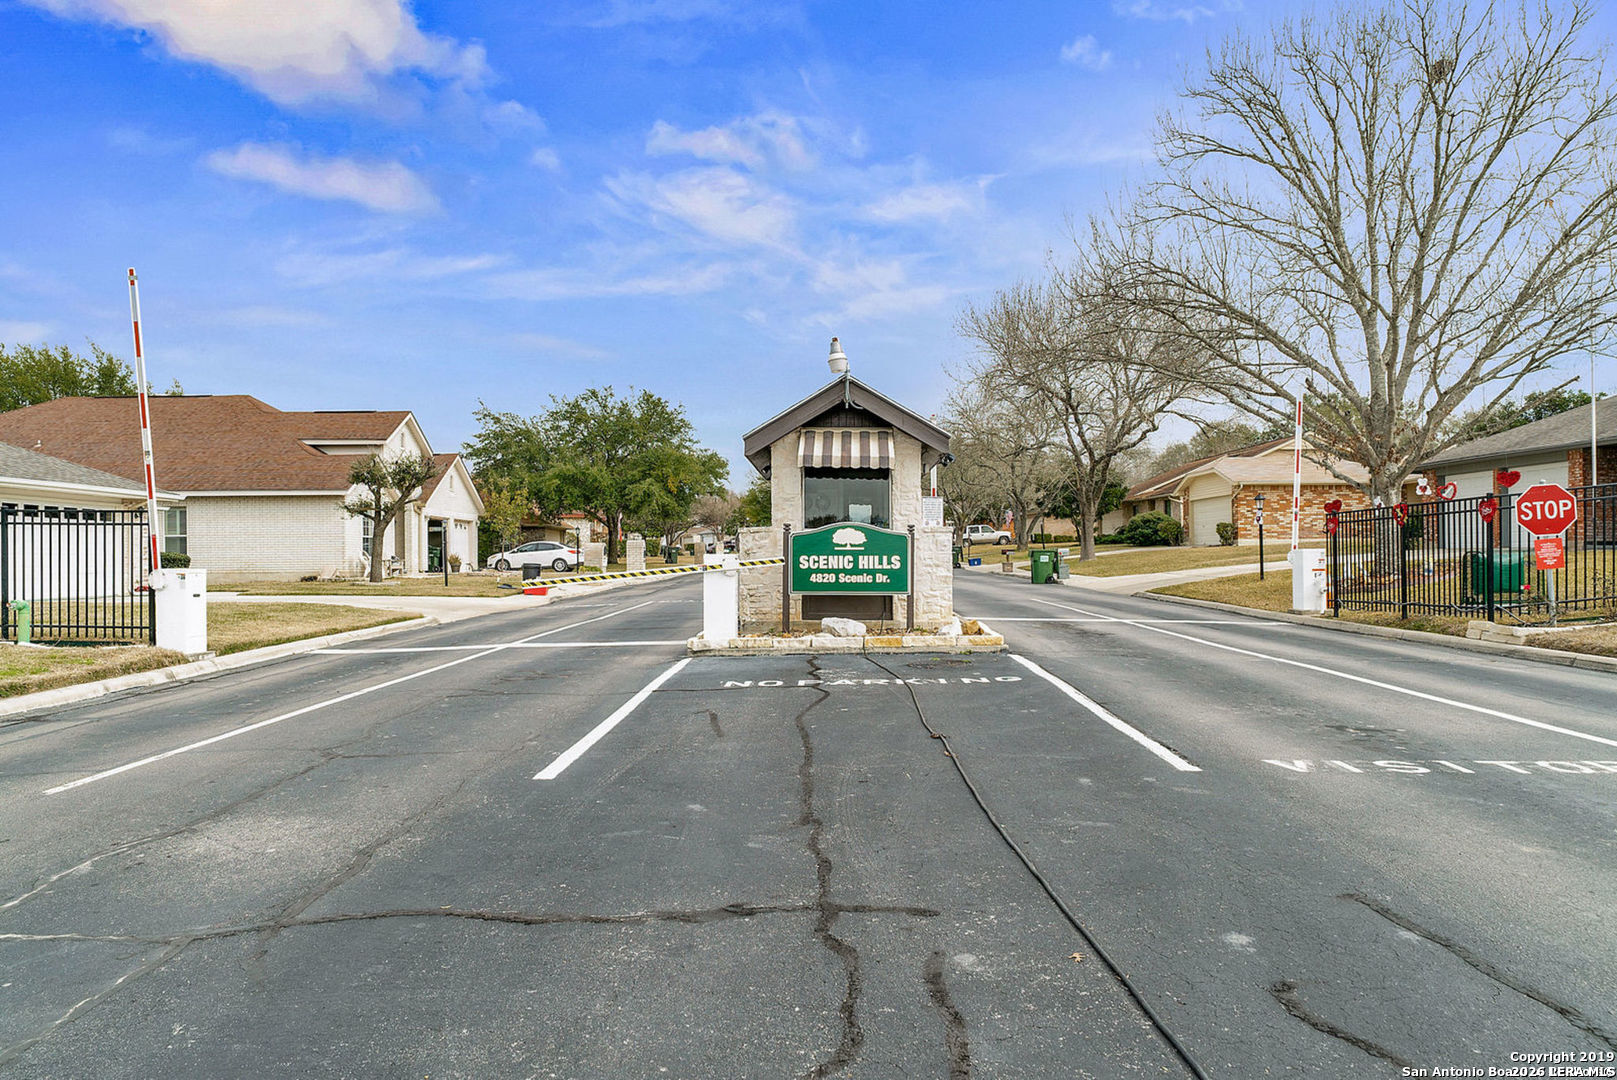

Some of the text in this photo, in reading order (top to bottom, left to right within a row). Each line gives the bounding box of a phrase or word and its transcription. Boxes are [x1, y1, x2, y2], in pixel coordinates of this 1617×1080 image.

[1520, 500, 1573, 521] STOP
[799, 555, 901, 570] SCENIC HILLS
[810, 572, 890, 583] 4820 Scenic Dr.
[797, 677, 1022, 687] PARKING
